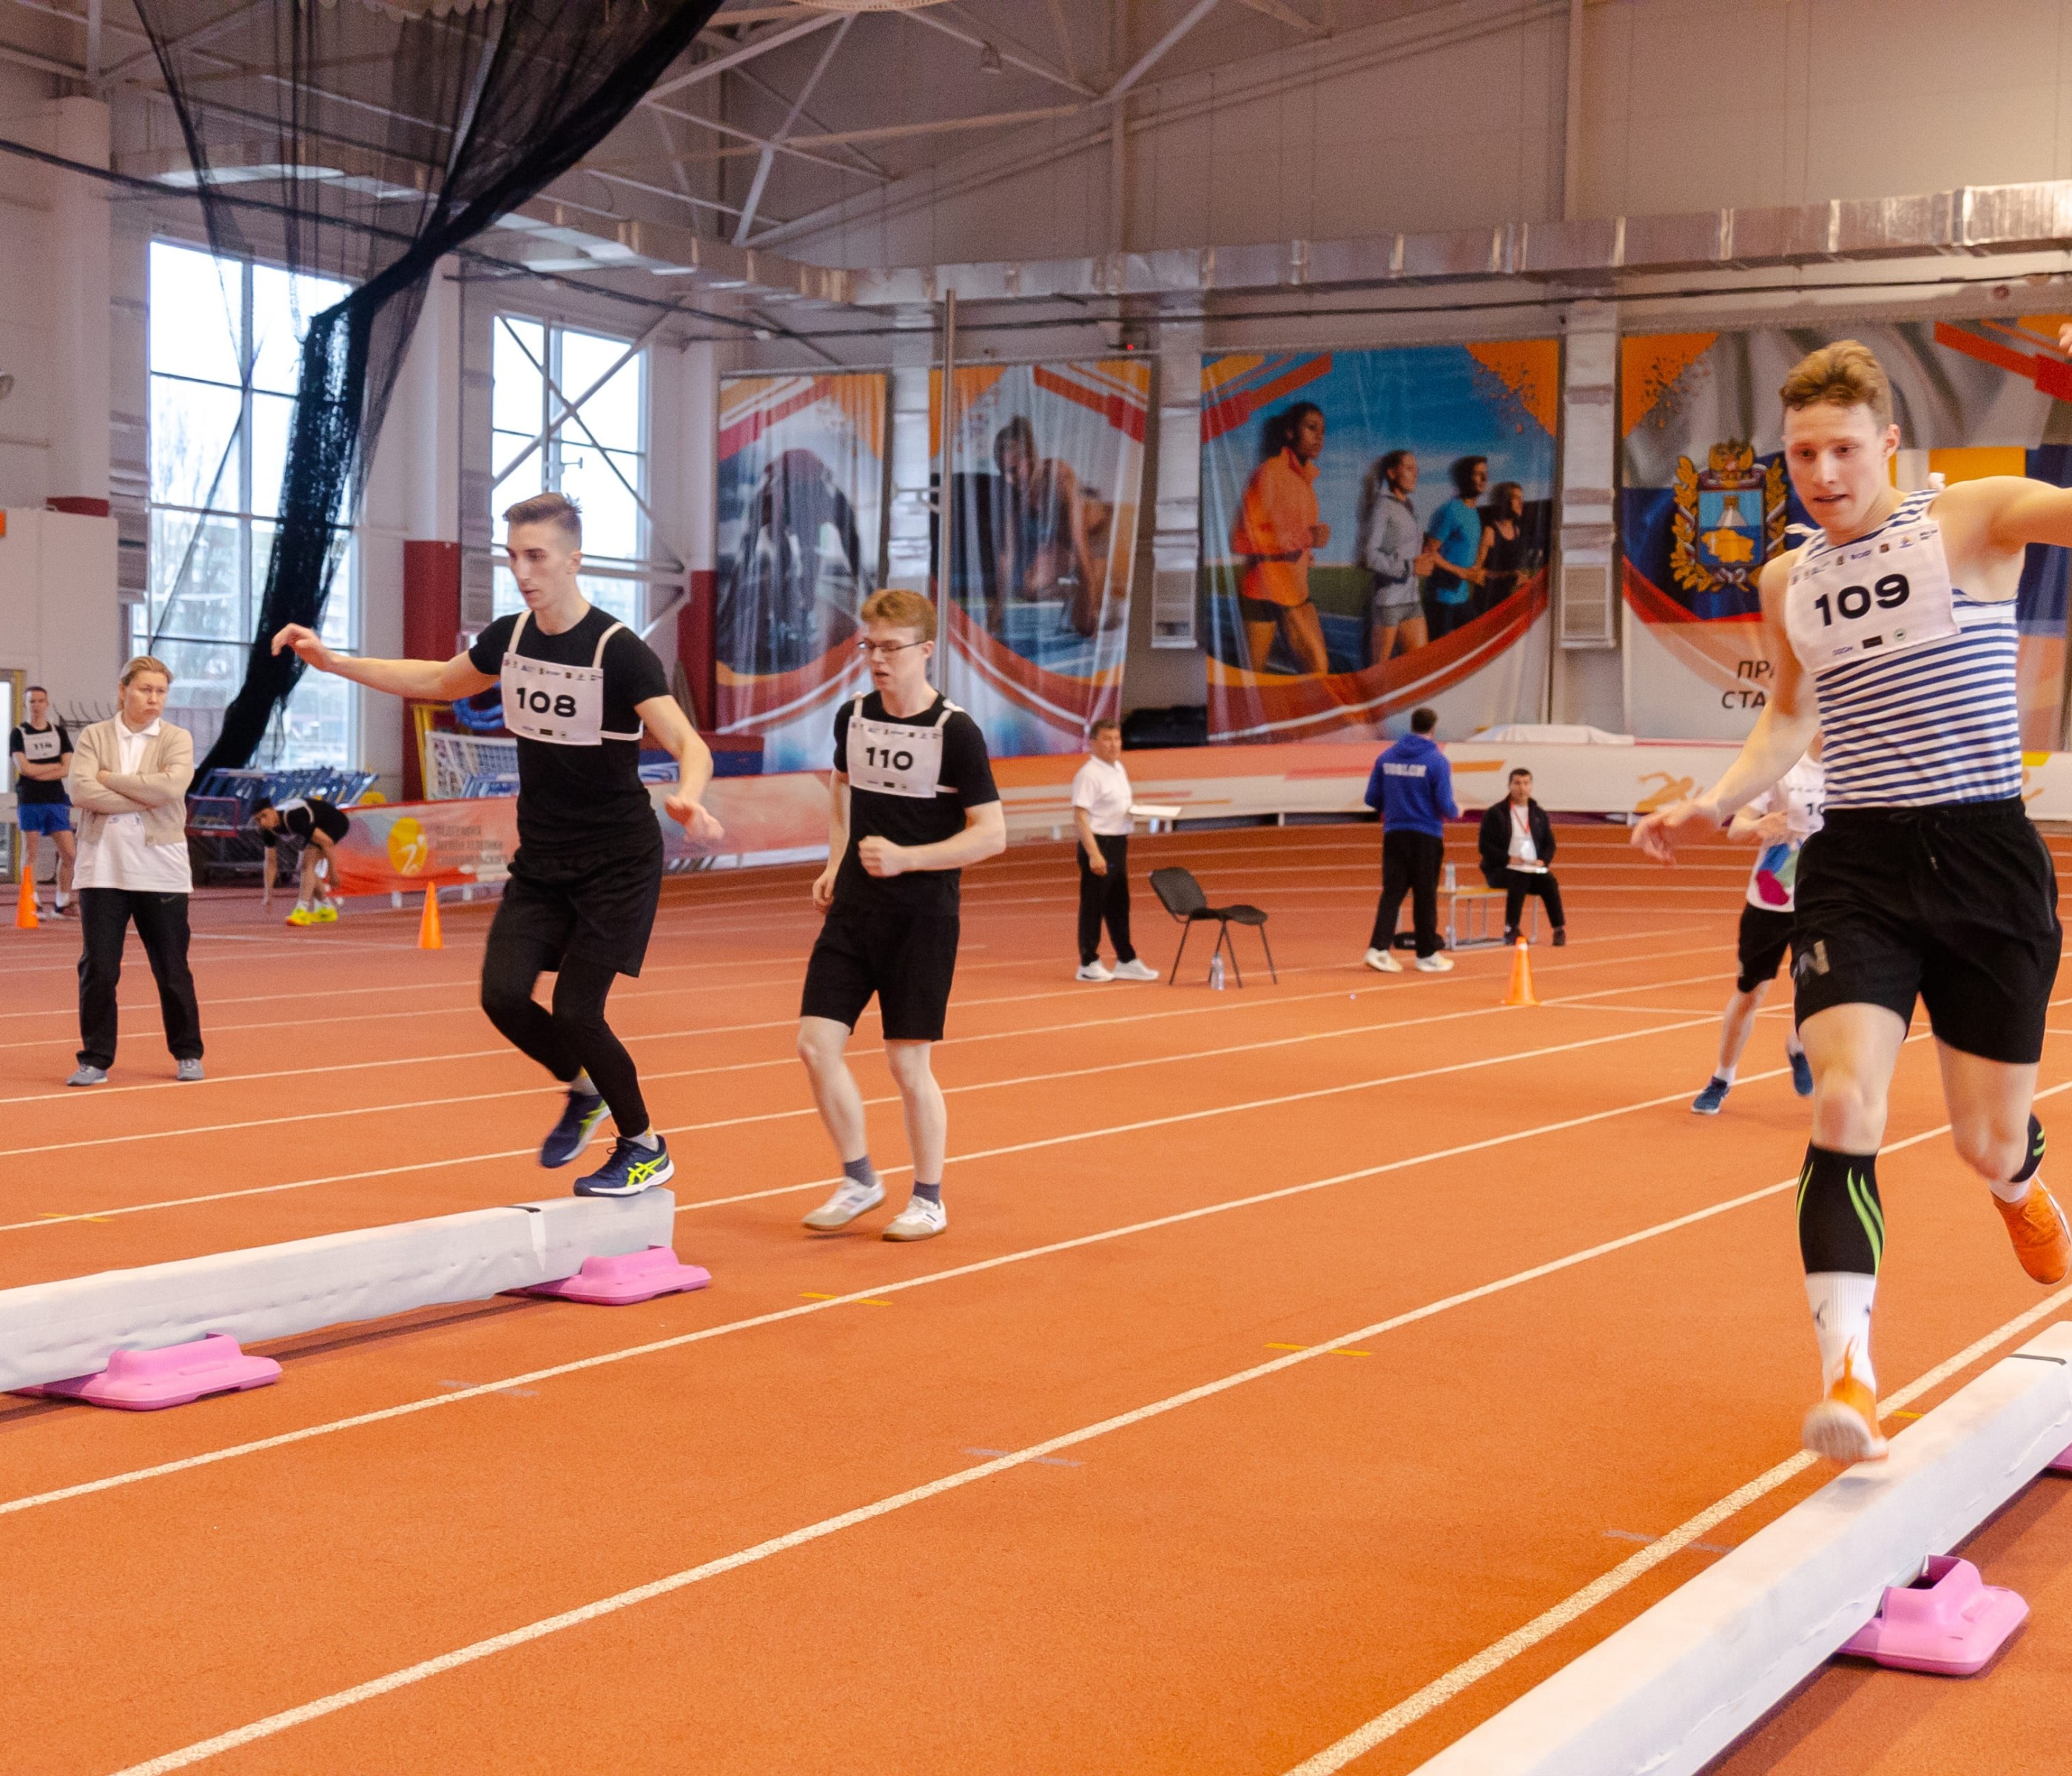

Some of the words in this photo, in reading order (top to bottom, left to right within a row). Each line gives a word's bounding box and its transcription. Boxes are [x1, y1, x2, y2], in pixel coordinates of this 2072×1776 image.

[1815, 574, 1910, 627] 109
[1738, 660, 1775, 679] ПР
[517, 687, 576, 718] 108
[1721, 690, 1766, 709] СТА
[866, 746, 913, 771] 110
